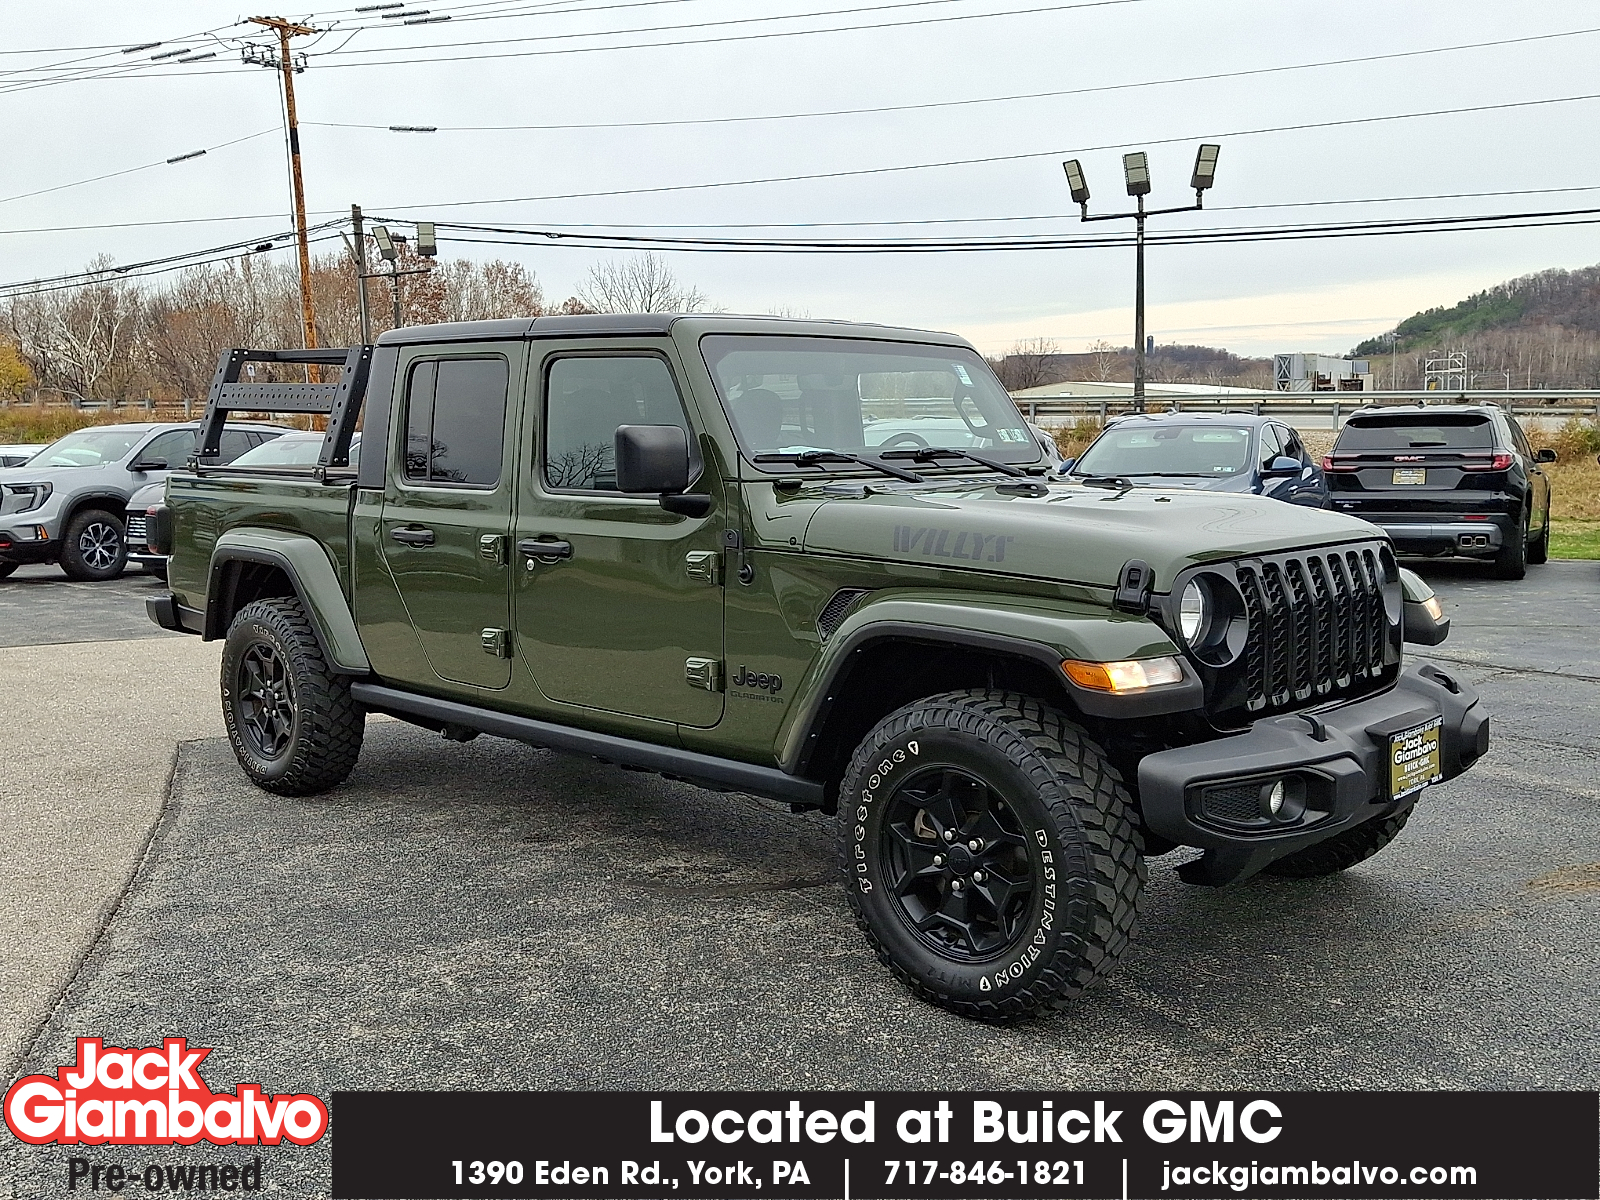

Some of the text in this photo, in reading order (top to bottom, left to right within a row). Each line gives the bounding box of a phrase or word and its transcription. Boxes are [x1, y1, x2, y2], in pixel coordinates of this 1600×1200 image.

[894, 525, 1014, 562] WILLYS
[732, 664, 783, 694] Jeep
[731, 690, 784, 704] GLADIATOR
[1394, 740, 1437, 765] Giambalvo
[1402, 734, 1423, 752] Jack
[995, 829, 1056, 988] DESTINATION
